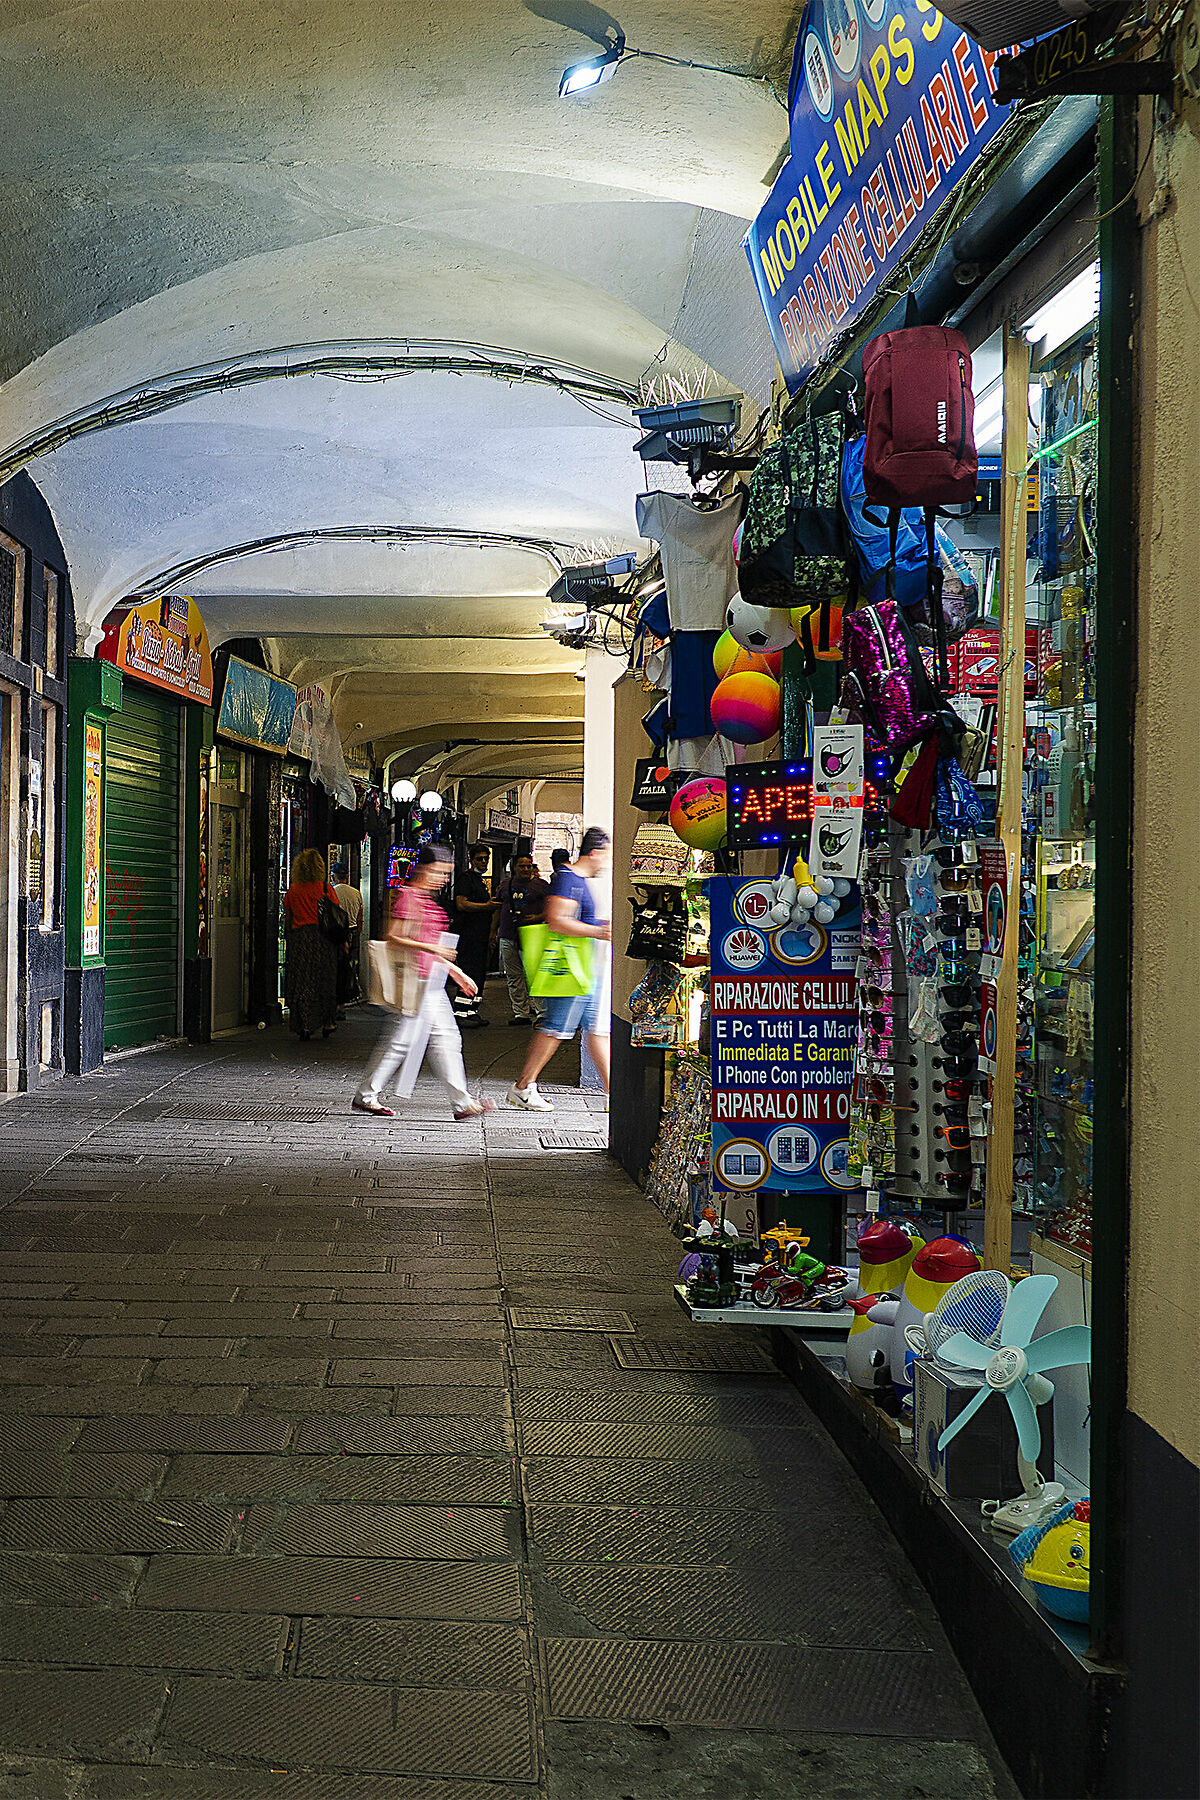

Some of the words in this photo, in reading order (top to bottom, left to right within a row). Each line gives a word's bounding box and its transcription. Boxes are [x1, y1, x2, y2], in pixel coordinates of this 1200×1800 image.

[759, 140, 842, 297] MOBILE
[833, 14, 915, 176] MAPS
[778, 201, 876, 373] RIPARAZIONE
[860, 62, 969, 262] CELLULARI
[951, 31, 989, 136] E
[936, 401, 947, 444] MAIQIU
[638, 785, 667, 795] ITALIA
[831, 955, 860, 963] SAMS
[714, 982, 800, 1010] RIPARAZIONE
[716, 1020, 727, 1038] E
[732, 1020, 753, 1038] Pc
[757, 1020, 793, 1038] Tutti
[798, 1020, 818, 1038] La
[718, 1043, 789, 1061] Immediata
[793, 1043, 803, 1061] E
[726, 1066, 767, 1084] Phone
[771, 1066, 798, 1084] Con
[717, 1093, 798, 1119] RIPARALO
[803, 1093, 819, 1119] IN
[823, 1093, 831, 1119] 1
